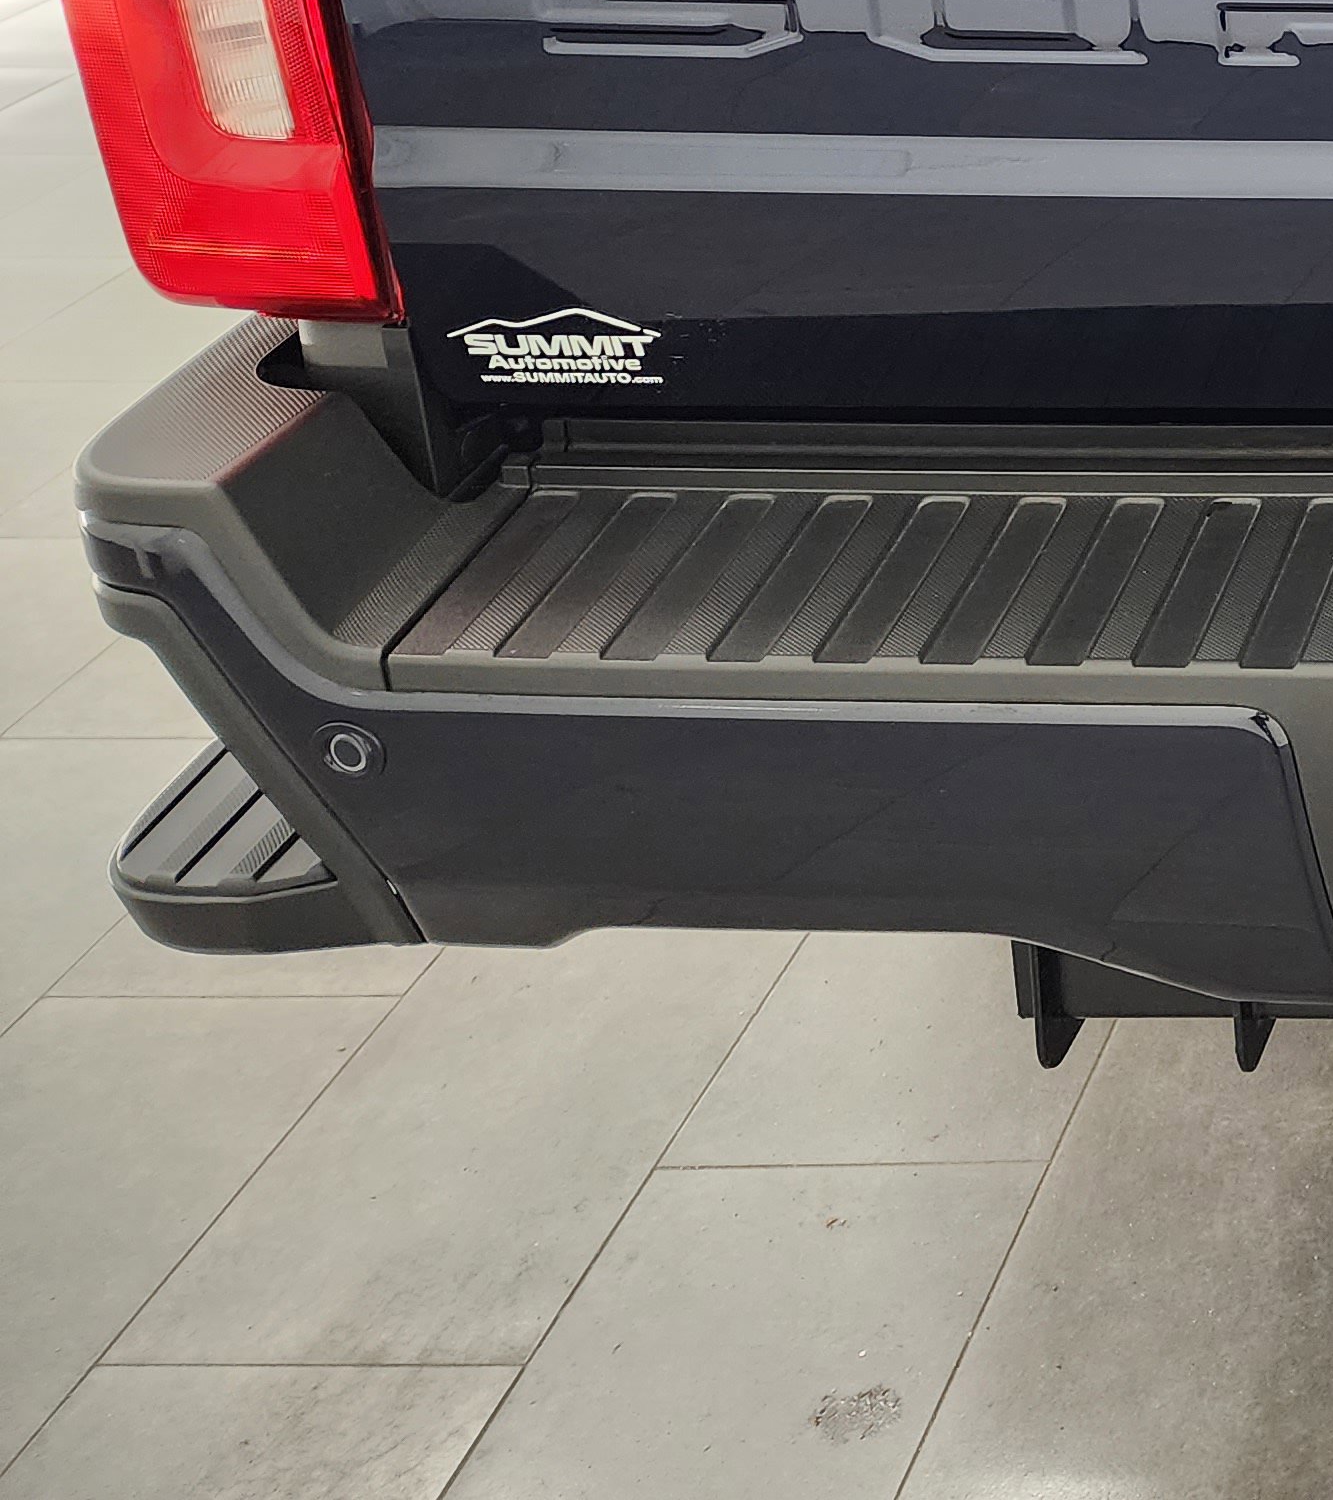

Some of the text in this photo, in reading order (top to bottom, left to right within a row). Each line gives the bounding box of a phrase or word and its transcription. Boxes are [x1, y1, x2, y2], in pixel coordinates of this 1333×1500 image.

[464, 335, 653, 356] SUMMIT
[489, 356, 642, 370] Automotive
[481, 372, 663, 384] www.SUMMITAUTO.com
